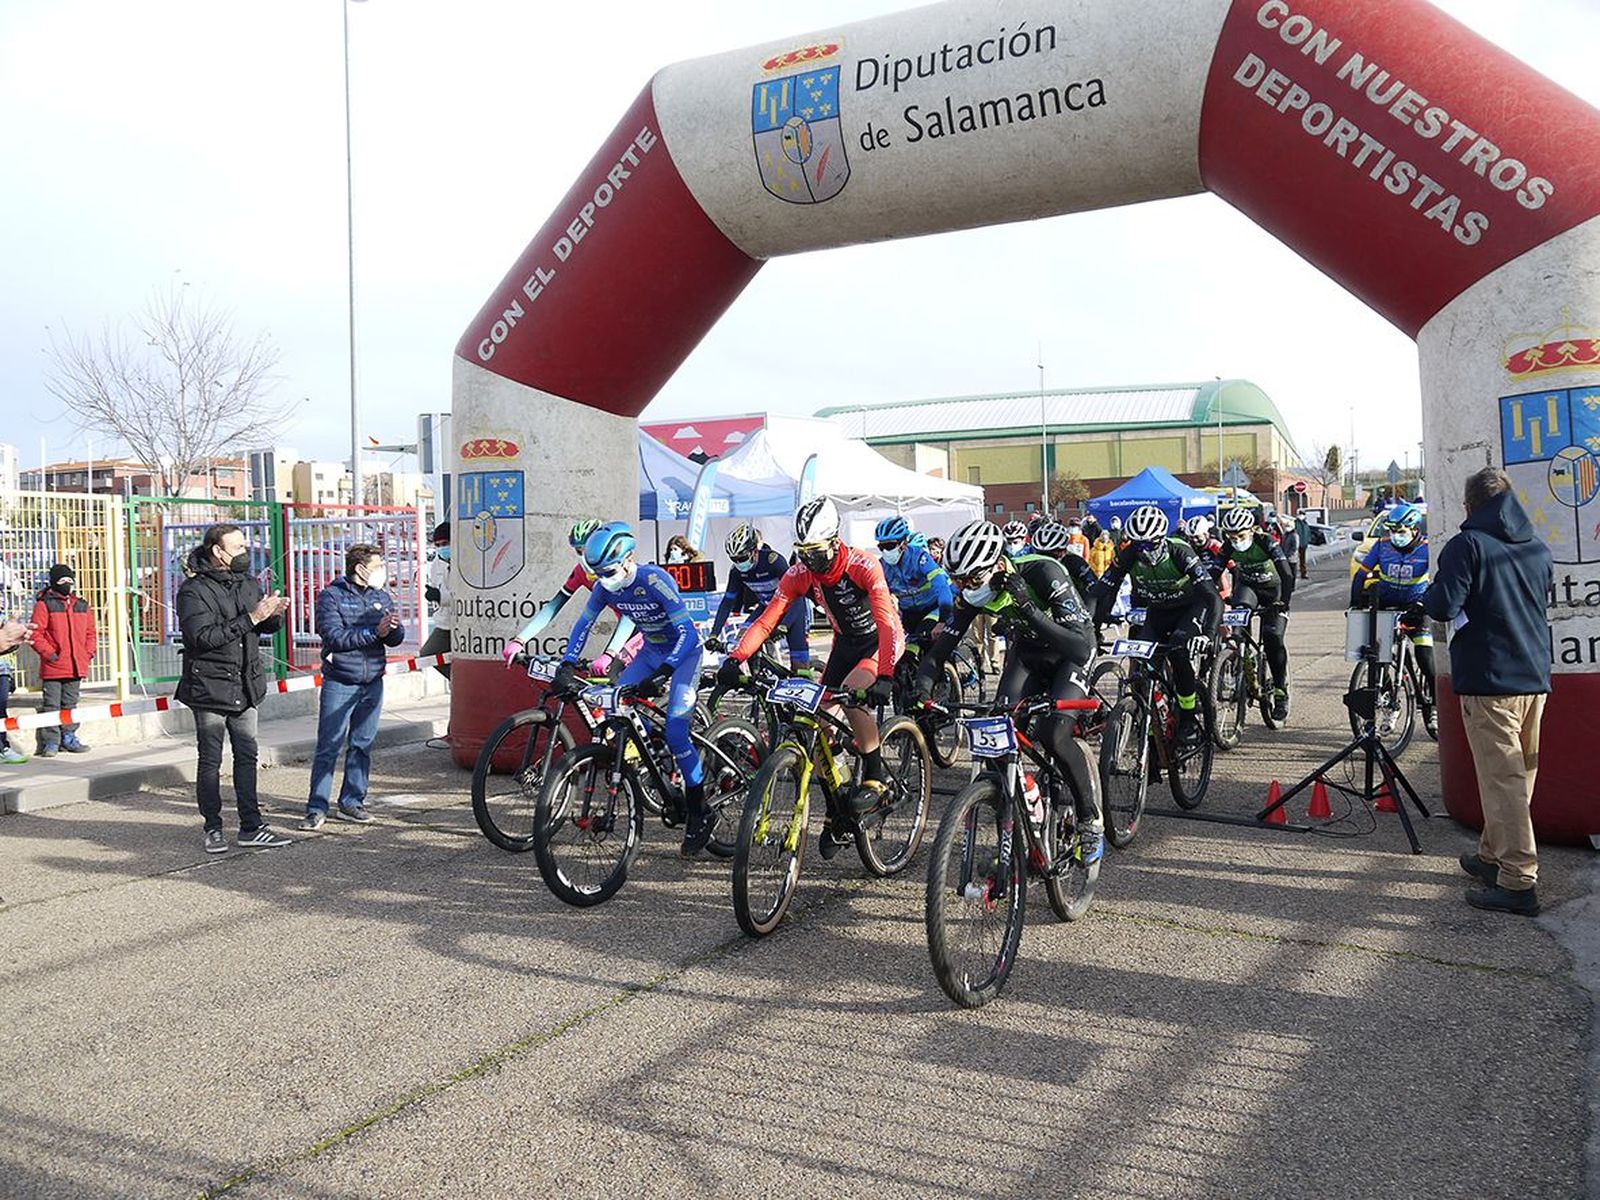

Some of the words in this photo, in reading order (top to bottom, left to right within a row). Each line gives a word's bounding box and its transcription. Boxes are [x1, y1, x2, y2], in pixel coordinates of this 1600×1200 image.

[854, 22, 1057, 93] Diputación
[860, 120, 891, 153] de
[905, 76, 1108, 144] Salamanca
[1256, 0, 1342, 65] CON
[1336, 53, 1554, 210] NUESTROS
[1233, 52, 1489, 246] DEPORTISTAS
[477, 297, 525, 362] CON
[522, 262, 555, 303] EL
[552, 125, 657, 261] DEPORTE
[453, 628, 569, 656] Salamnca
[454, 591, 550, 622] putació
[616, 602, 659, 611] CIUDAD
[979, 730, 997, 747] 53
